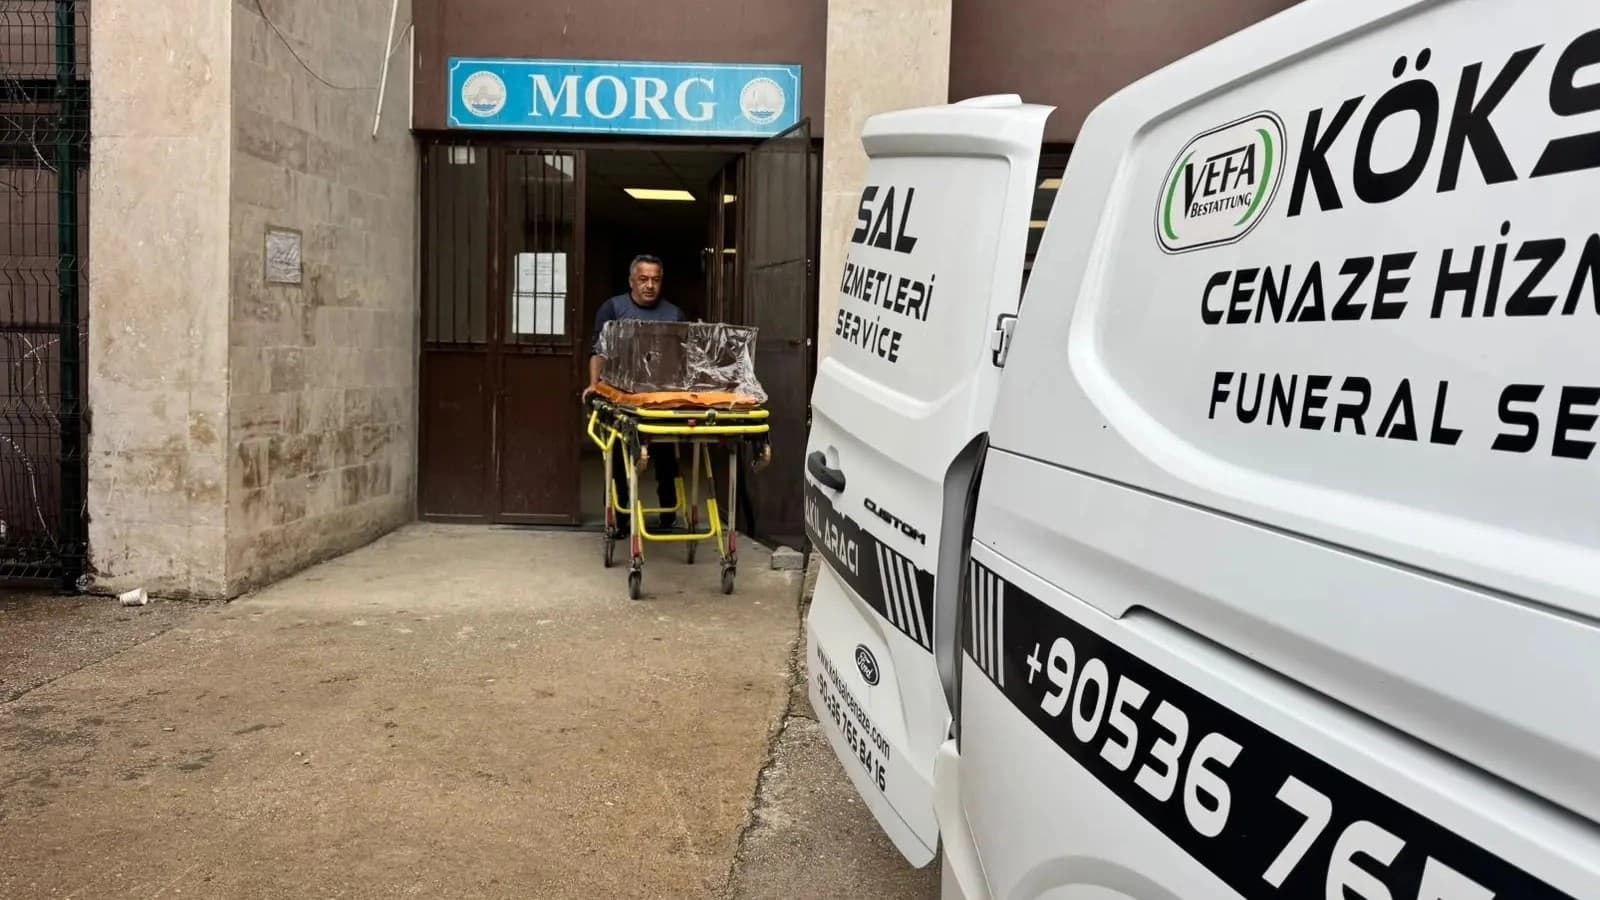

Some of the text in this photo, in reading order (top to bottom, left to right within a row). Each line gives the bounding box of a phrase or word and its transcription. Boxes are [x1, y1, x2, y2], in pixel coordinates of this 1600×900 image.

[528, 73, 718, 121] MORG
[1185, 143, 1255, 219] VEFA
[851, 186, 918, 254] SAL
[840, 253, 935, 322] İZMETLERİ
[1201, 251, 1418, 325] CENAZE
[835, 308, 902, 364] SERVİCE
[1208, 371, 1600, 460] FUNERAL SE
[824, 517, 859, 577] ARACI
[864, 498, 927, 545] CUSTOM
[842, 711, 858, 753] 765
[859, 737, 873, 774] 84
[875, 758, 887, 793] 16
[1026, 637, 1243, 838] +90536
